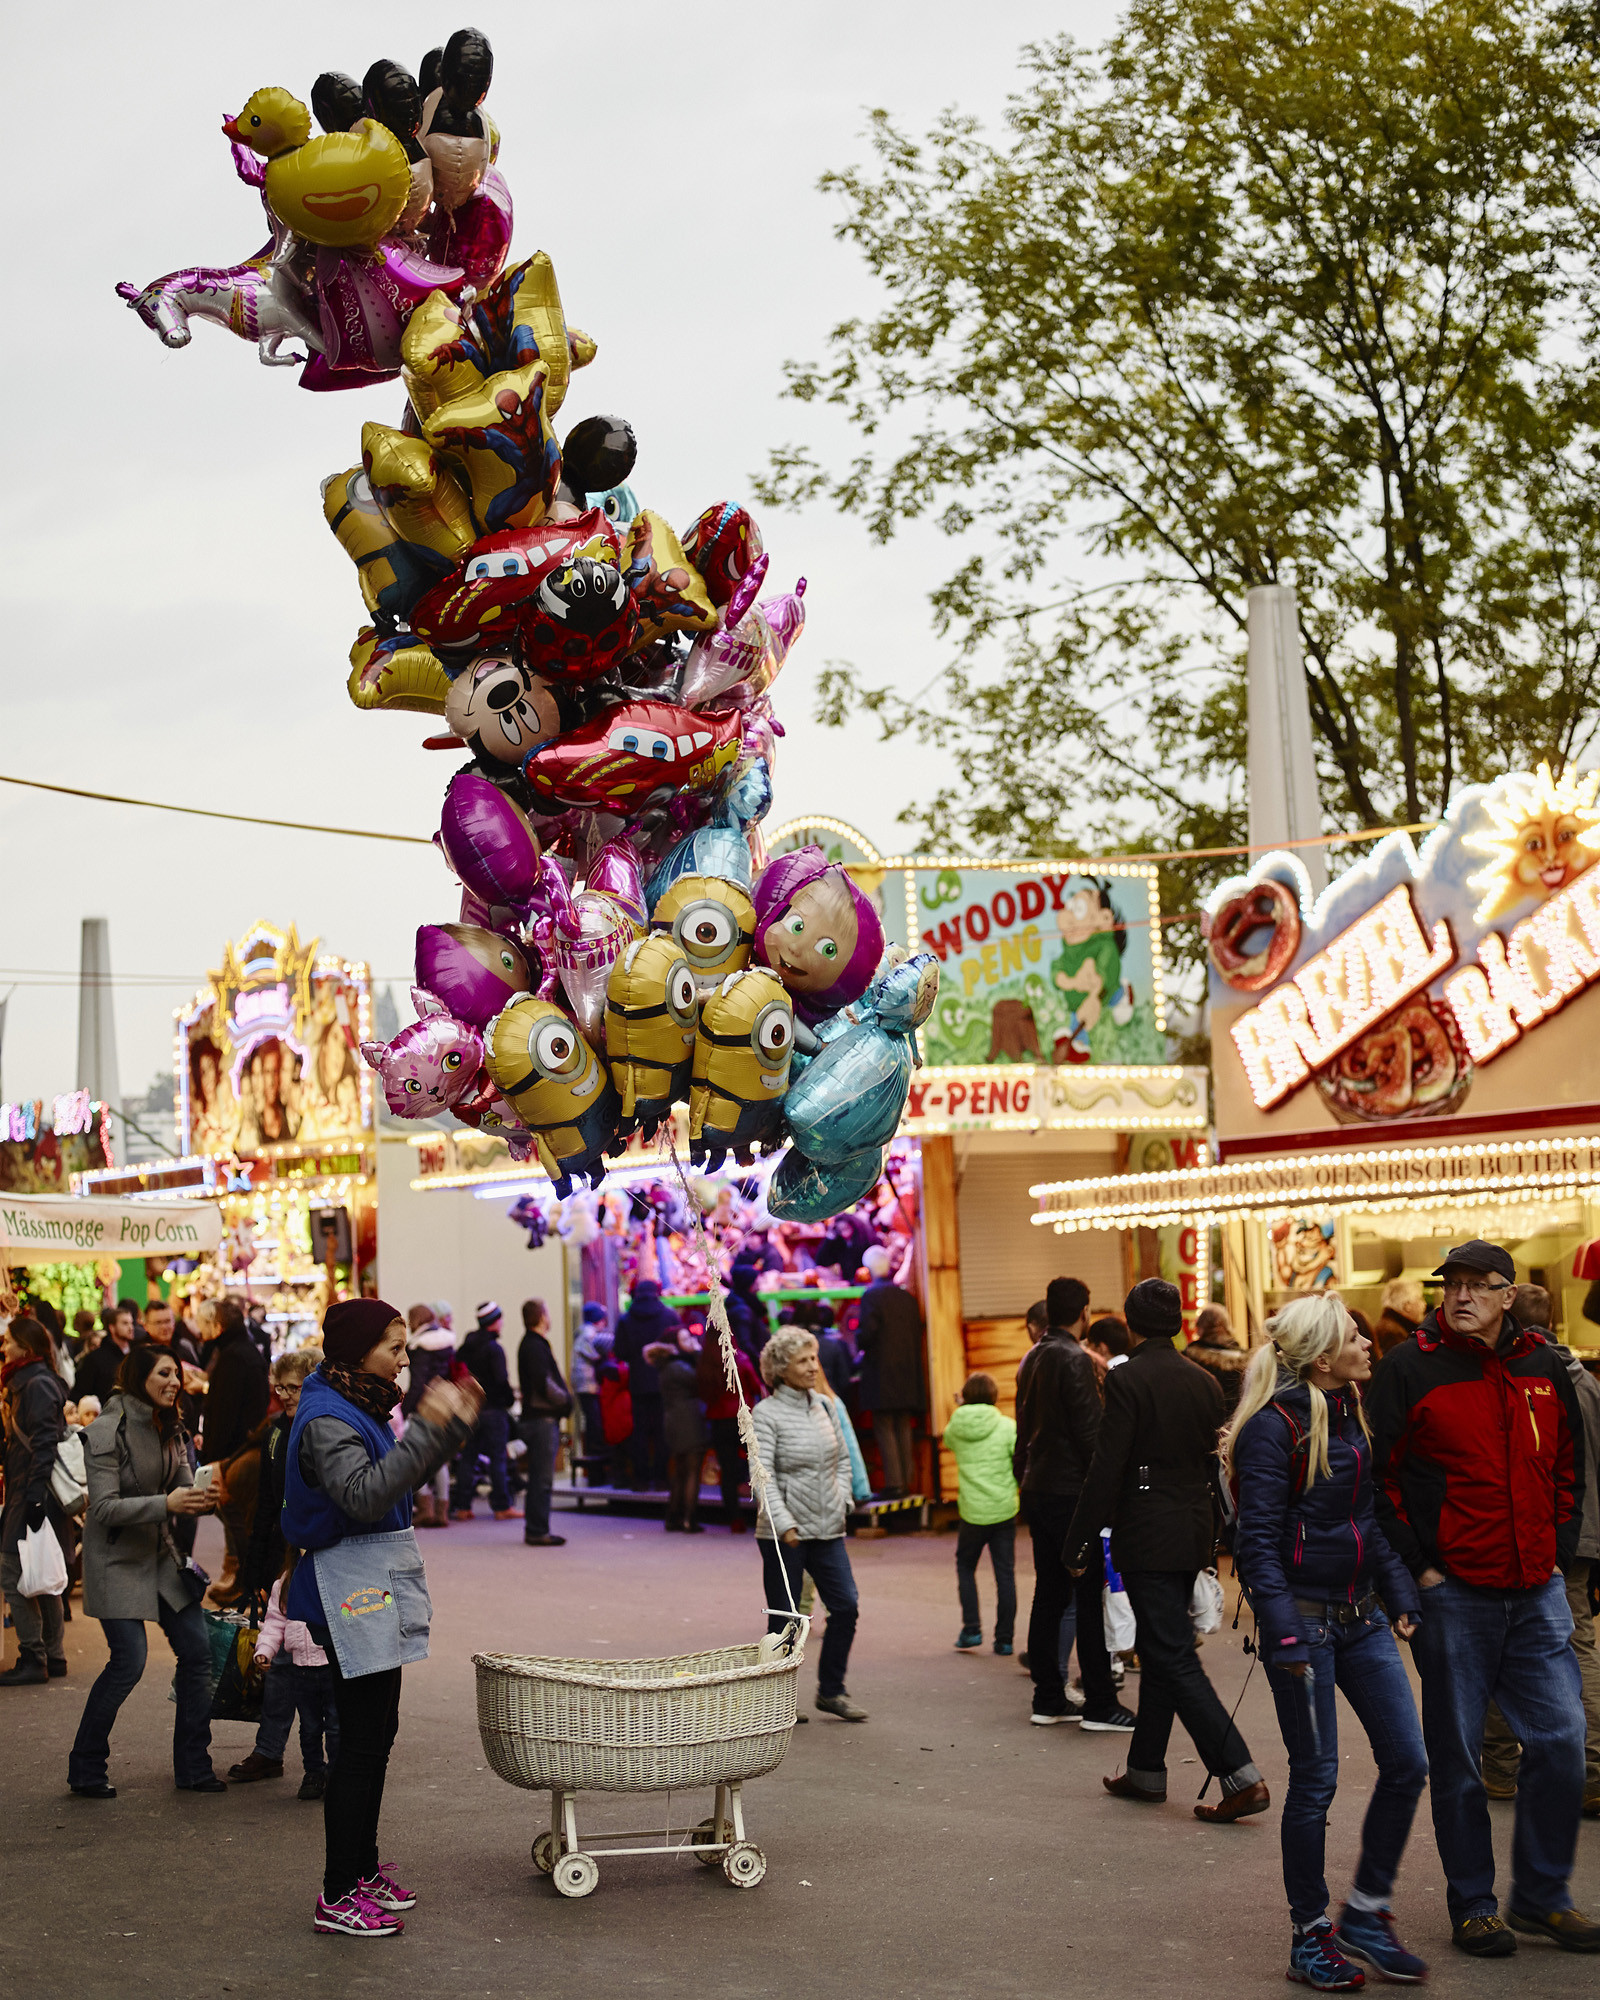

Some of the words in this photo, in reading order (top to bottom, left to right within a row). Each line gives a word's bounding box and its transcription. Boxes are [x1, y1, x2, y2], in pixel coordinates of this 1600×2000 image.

[922, 873, 1069, 962] WOODY
[960, 923, 1042, 997] PENG
[1316, 1157, 1471, 1185] OFENFRISCHE
[1480, 1151, 1578, 1177] BUTTER
[3, 1209, 104, 1248] Mässmogge
[120, 1215, 151, 1248] Pop
[155, 1217, 198, 1242] Corn
